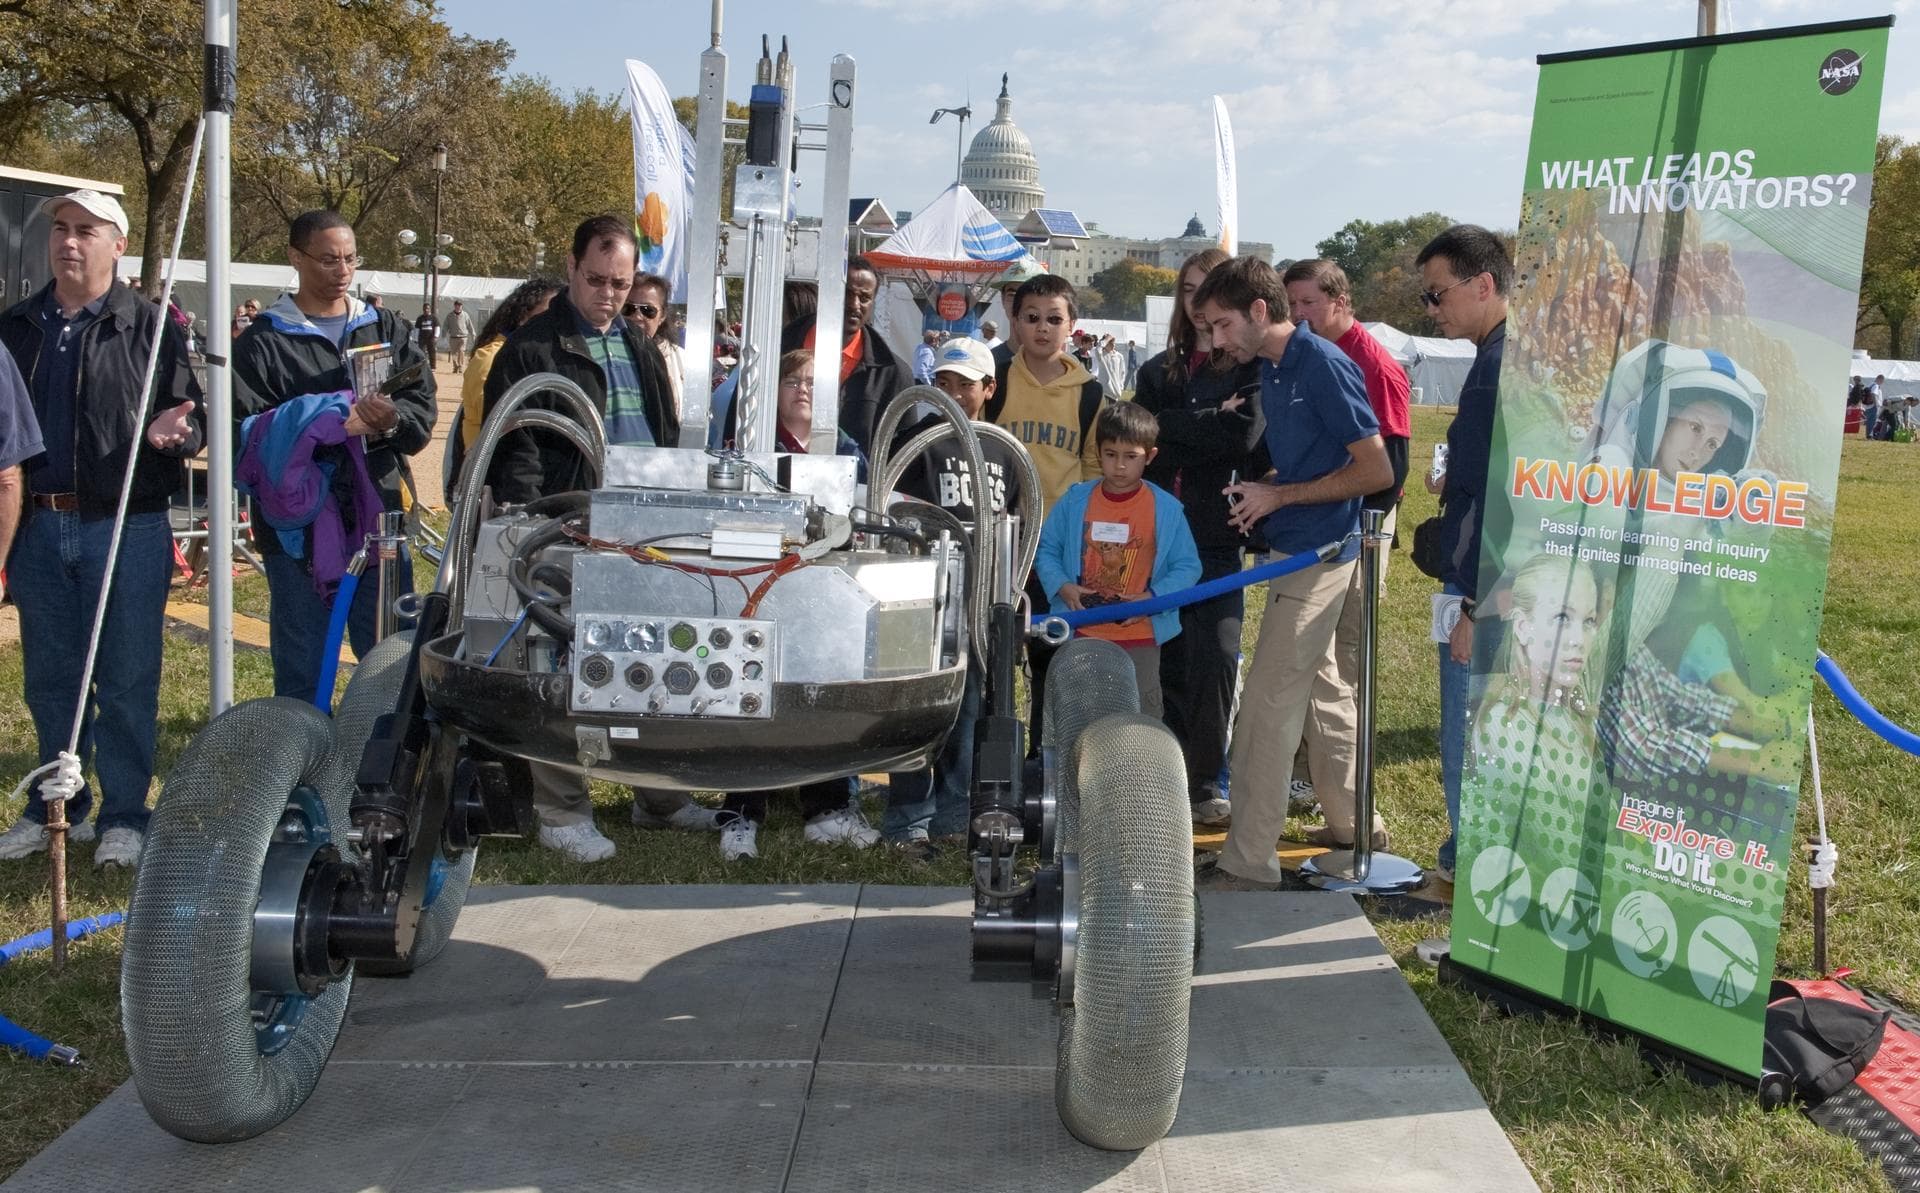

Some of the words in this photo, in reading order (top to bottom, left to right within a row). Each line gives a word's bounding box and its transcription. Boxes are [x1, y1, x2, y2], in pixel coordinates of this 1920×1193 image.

[1822, 65, 1859, 79] NASA
[1541, 157, 1634, 189] WHAT
[1640, 149, 1755, 185] LEADS
[1608, 173, 1856, 214] INNOVATORS?
[900, 256, 928, 266] clean
[932, 259, 977, 270] charging
[945, 457, 969, 472] I'M
[985, 462, 1004, 477] THE
[1512, 456, 1808, 529] KNOWLEDGE
[1540, 518, 1596, 538] Passion
[1599, 525, 1617, 541] for
[1620, 527, 1680, 552] learning
[1684, 536, 1713, 553] and
[1716, 540, 1770, 564] inquiry
[1545, 541, 1574, 557] that
[1577, 544, 1620, 564] ignites
[1624, 552, 1711, 576] unimagined
[1715, 562, 1758, 583] ideas
[1623, 792, 1675, 819] Imagine
[1616, 806, 1736, 859] Explore
[1742, 839, 1775, 873] it.
[1654, 841, 1688, 877] Do
[1692, 850, 1717, 886] it.
[1625, 862, 1642, 874] Who
[1642, 865, 1669, 882] Knows
[1670, 877, 1690, 889] What
[1690, 882, 1712, 896] You'll
[1713, 889, 1753, 908] Discover?
